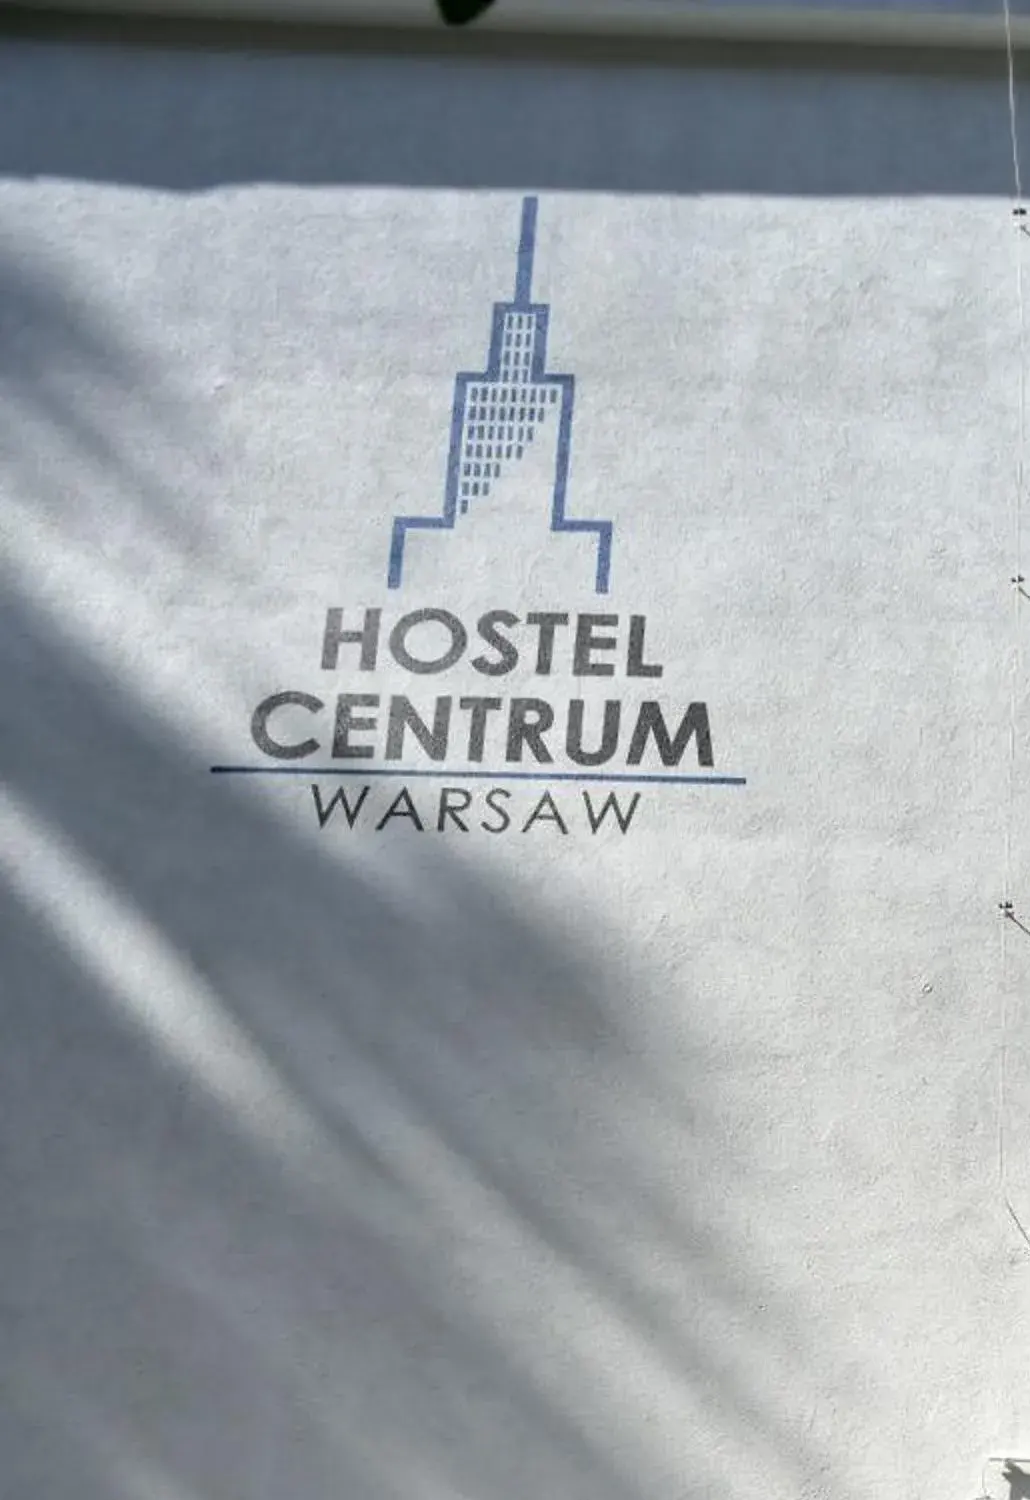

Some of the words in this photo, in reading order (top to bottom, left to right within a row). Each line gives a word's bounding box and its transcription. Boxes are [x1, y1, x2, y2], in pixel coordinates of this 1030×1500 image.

[320, 607, 663, 678] HOSTEL
[250, 690, 714, 767] CENTRUM
[311, 783, 641, 835] WARSAW
